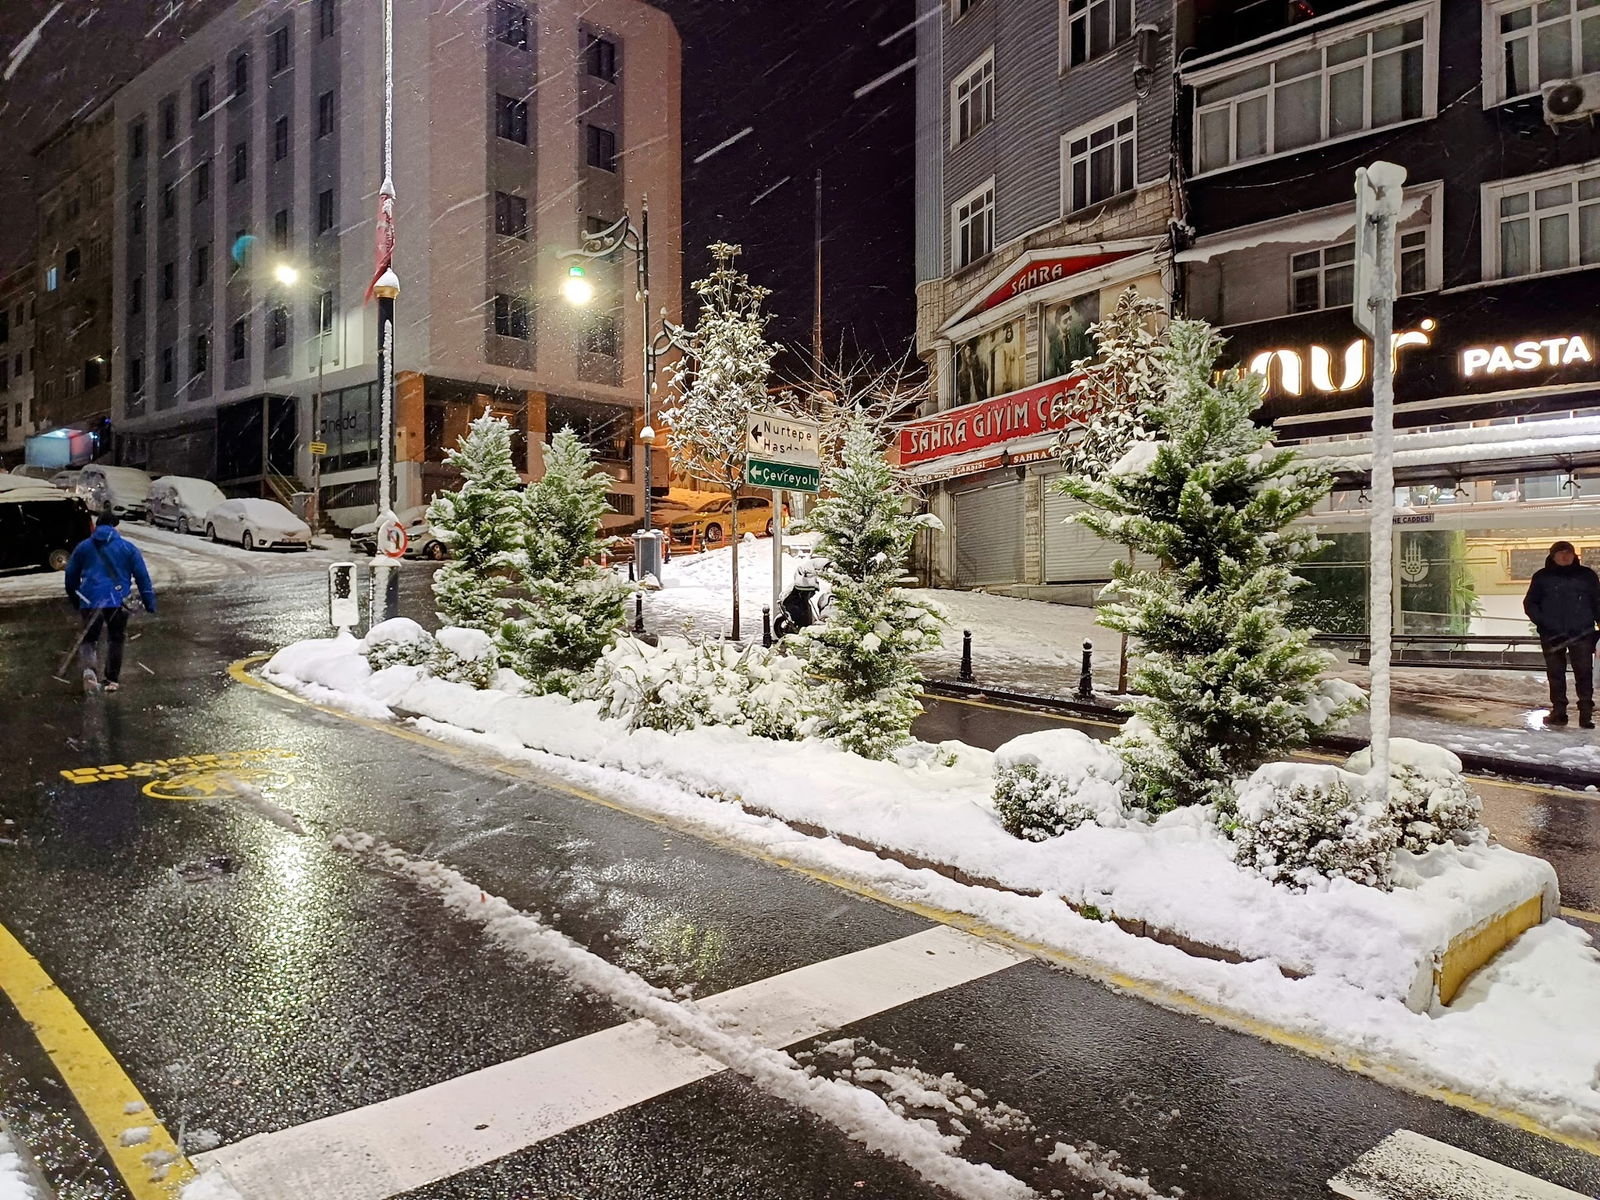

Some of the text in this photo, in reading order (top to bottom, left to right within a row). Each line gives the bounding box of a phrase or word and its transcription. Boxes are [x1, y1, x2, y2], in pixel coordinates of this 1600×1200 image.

[1011, 263, 1063, 295] SAHRA
[1463, 335, 1593, 377] PASTA
[763, 420, 812, 442] Nurtepe
[910, 418, 967, 454] SAHRA
[972, 398, 1030, 438] GİYİM
[1013, 450, 1048, 464] SAHRA
[762, 467, 819, 487] Çevreyolu
